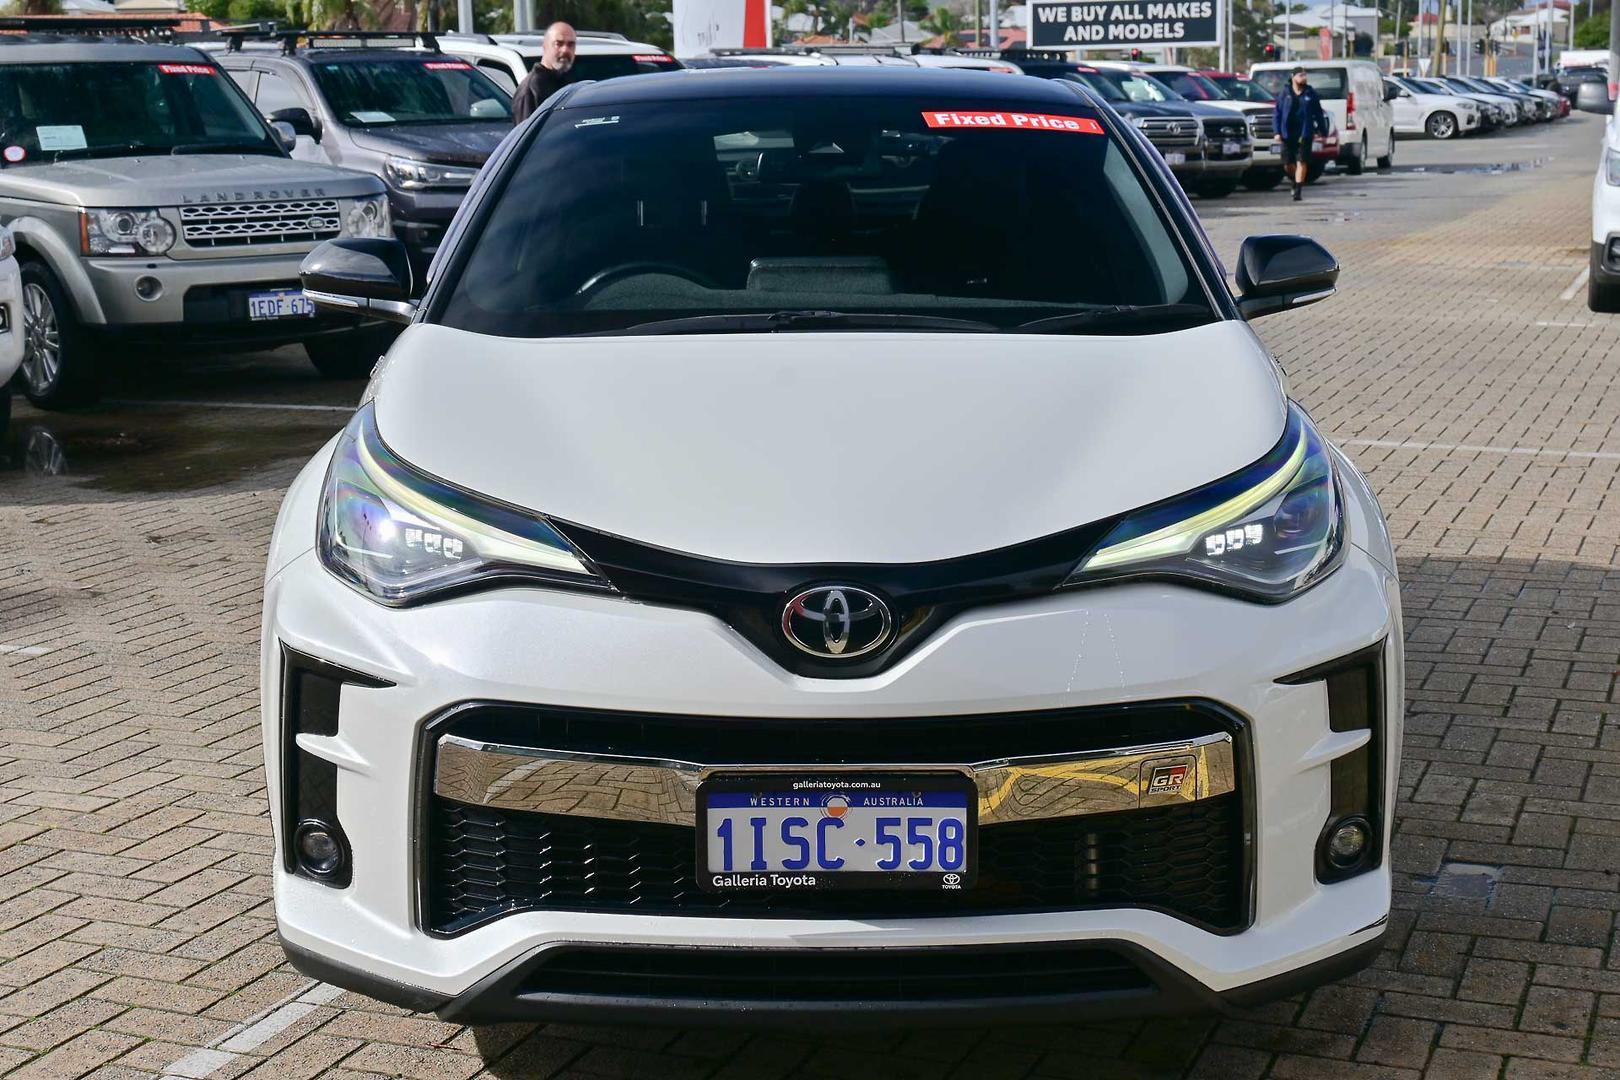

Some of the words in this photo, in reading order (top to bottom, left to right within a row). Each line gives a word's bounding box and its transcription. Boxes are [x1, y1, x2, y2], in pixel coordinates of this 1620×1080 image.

[1037, 6, 1067, 23] WE
[1071, 6, 1107, 22] BUY
[1110, 4, 1144, 21] ALL
[1147, 2, 1212, 19] MAKES
[1063, 24, 1105, 42] AND
[1108, 22, 1185, 40] MODELS
[935, 113, 1006, 126] Fixed
[1011, 115, 1080, 130] Price
[792, 781, 881, 790] galleriatoyota.com.au
[1153, 773, 1184, 787] GR
[1150, 785, 1181, 793] SPORT
[750, 797, 811, 807] WESTERN
[863, 797, 924, 807] AUSTRALIA
[712, 874, 767, 888] Galleria
[770, 874, 816, 890] Toyota
